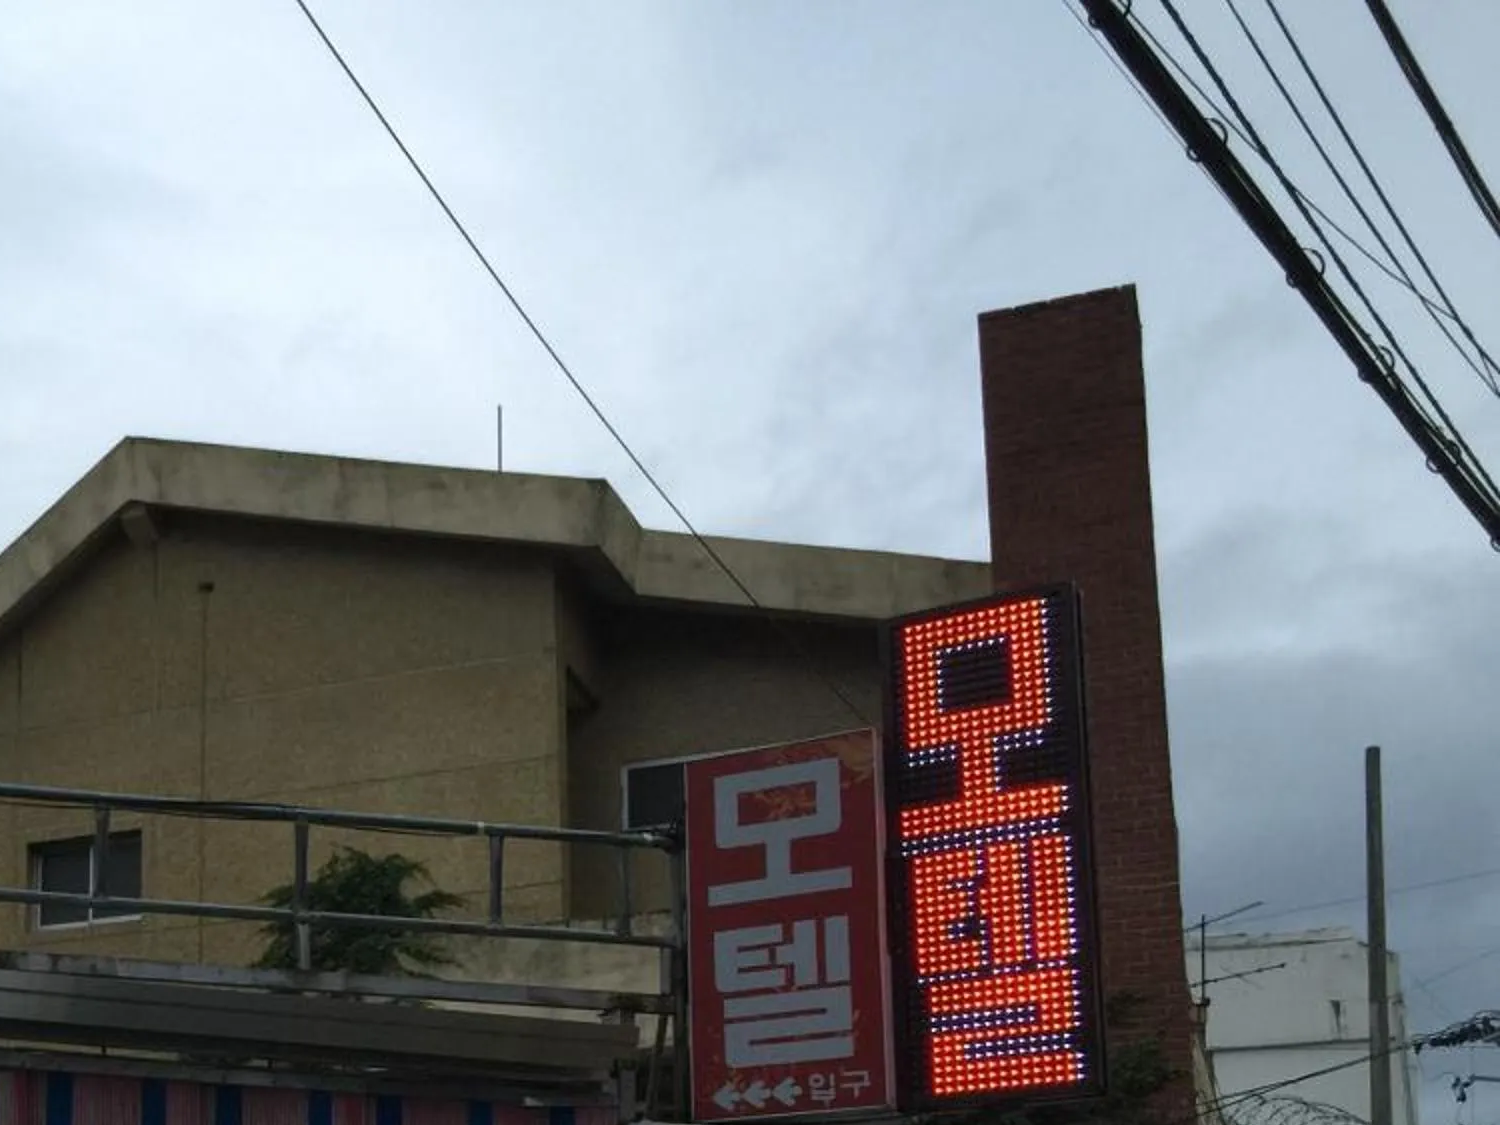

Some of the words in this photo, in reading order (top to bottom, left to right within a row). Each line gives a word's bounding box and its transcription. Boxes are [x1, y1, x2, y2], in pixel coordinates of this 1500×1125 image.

[707, 757, 855, 1069] 모텔
[902, 598, 1086, 1096] 모텔
[807, 1069, 872, 1106] 입구
